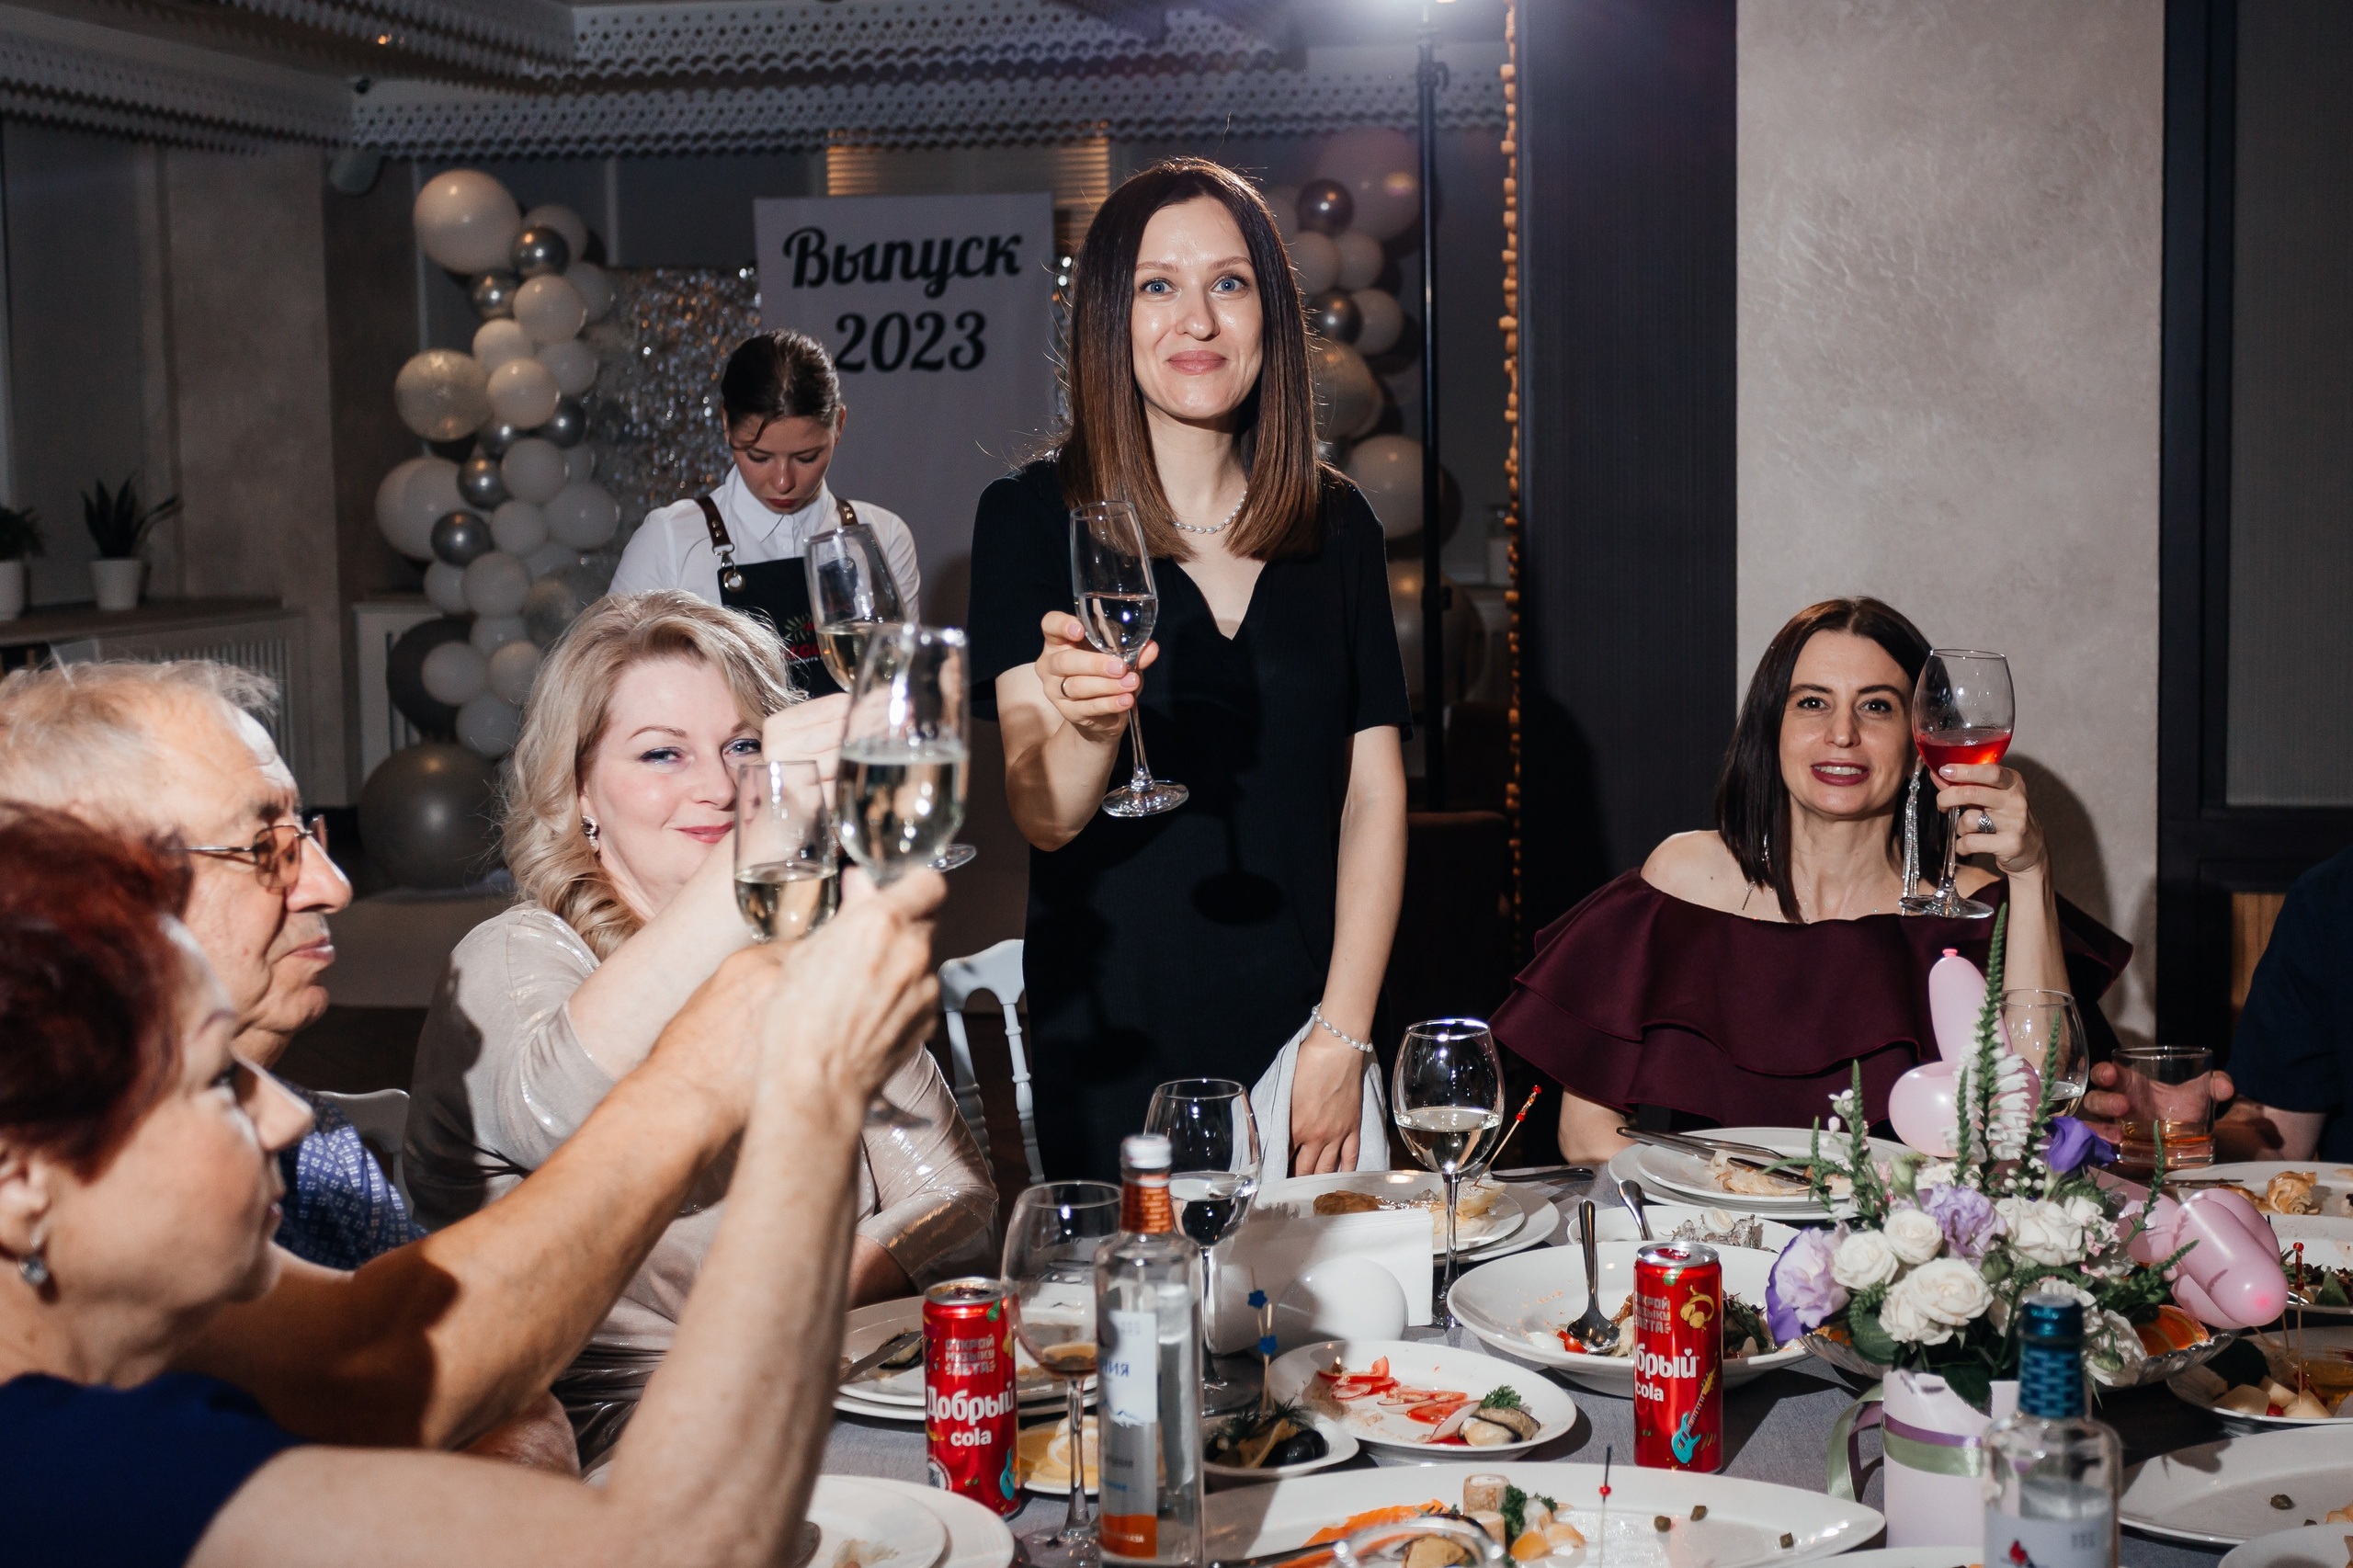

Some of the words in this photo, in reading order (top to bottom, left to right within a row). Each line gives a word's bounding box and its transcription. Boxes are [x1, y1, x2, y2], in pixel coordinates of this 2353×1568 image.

[783, 226, 1022, 299] Выпуск
[834, 310, 986, 373] 2023
[1633, 1343, 1697, 1380] брый
[926, 1381, 1014, 1426] Добрый
[1636, 1381, 1664, 1403] cola
[950, 1427, 992, 1447] cola
